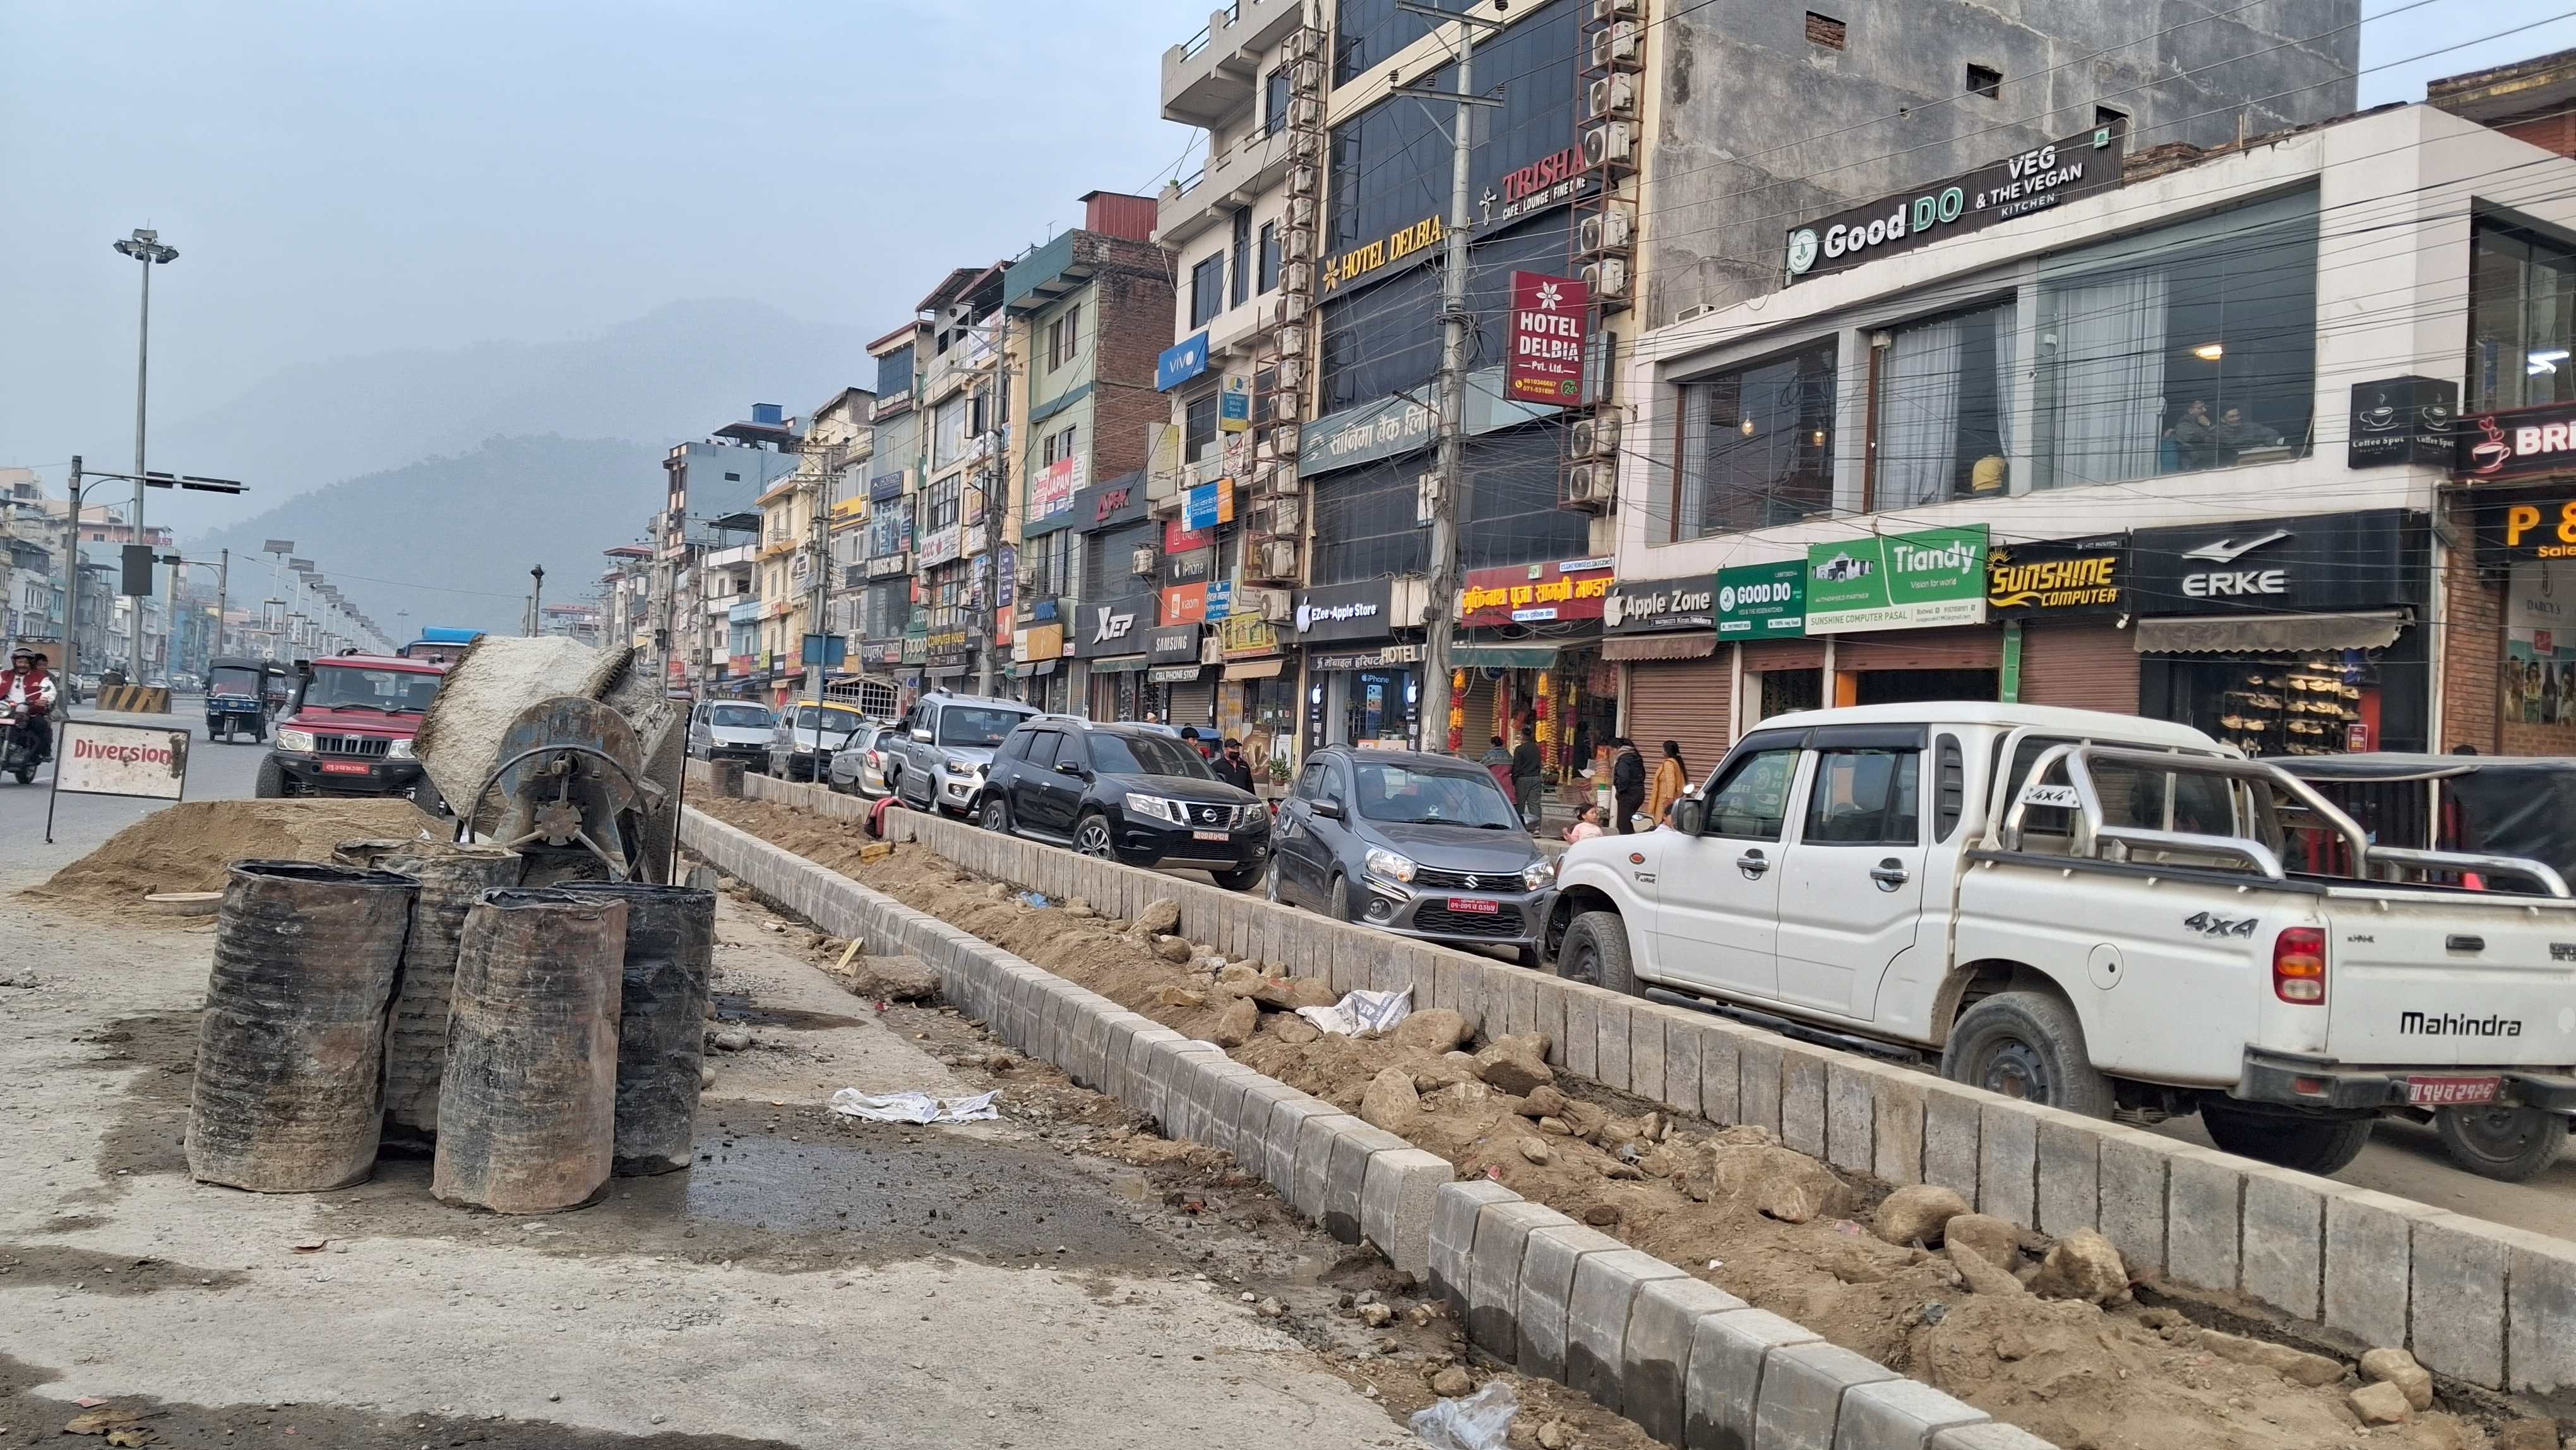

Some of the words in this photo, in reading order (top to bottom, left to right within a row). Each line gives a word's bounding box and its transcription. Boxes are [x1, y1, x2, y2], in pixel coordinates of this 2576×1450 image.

[1503, 142, 1587, 203] TRISHA
[2009, 145, 2056, 179] VEG
[1976, 193, 1986, 209] &
[1990, 182, 2021, 204] THE
[2024, 162, 2082, 193] VEGAN
[1503, 203, 1519, 220] CAFE
[1523, 190, 1549, 212] LOUNGE
[1553, 183, 1568, 200] FINE
[1570, 177, 1586, 193] DNE
[2001, 193, 2055, 217] KITCHEN
[1825, 203, 1907, 258] Good
[1913, 186, 1964, 232] DO
[1342, 239, 1386, 281] HOTEL
[1390, 214, 1441, 261] DELBIA
[1520, 311, 1580, 338] HOTEL
[1519, 335, 1579, 362] DELBIA
[1169, 350, 1194, 374] vivo
[1330, 422, 1374, 455] सानिमा
[1377, 414, 1400, 445] बैंक
[1047, 471, 1070, 496] JAPAN
[2508, 506, 2541, 546] P
[872, 558, 890, 575] MUSIC
[1183, 560, 1203, 577] iPhone
[1893, 540, 1977, 575] Tiandy
[1911, 579, 1929, 589] Vision
[1930, 578, 1939, 587] for
[1940, 577, 1957, 587] world
[1991, 557, 2116, 594] SUNSHINE
[2182, 570, 2285, 597] ERKE
[1181, 598, 1200, 610] xiaomi
[1463, 586, 1508, 614] मुक्तिनाथ
[1510, 585, 1532, 609] पूजा
[1535, 575, 1573, 604] सामग्री
[1625, 592, 1666, 621] Apple
[1671, 590, 1710, 612] Zone
[1737, 584, 1771, 604] GOOD
[1773, 582, 1791, 602] DO
[2041, 588, 2118, 607] COMPUTER
[1354, 602, 1377, 617] Store
[1811, 615, 1845, 626] SUNSHINE
[1846, 613, 1883, 625] COMPUTER
[1884, 610, 1908, 621] PASAL
[905, 637, 927, 658] oppo
[928, 633, 950, 647] COMPUTER
[951, 631, 965, 644] HOUSE
[1155, 635, 1188, 652] SAMSUNG
[1325, 656, 1352, 669] मोबाइल
[1381, 644, 1420, 663] HOTEL
[1166, 670, 1183, 680] PHONE
[1367, 673, 1390, 684] iPhone
[74, 738, 172, 765] Diversion
[2031, 788, 2066, 802] 4x4
[2184, 911, 2260, 939] 4x4
[2400, 1011, 2522, 1036] Mahindra
